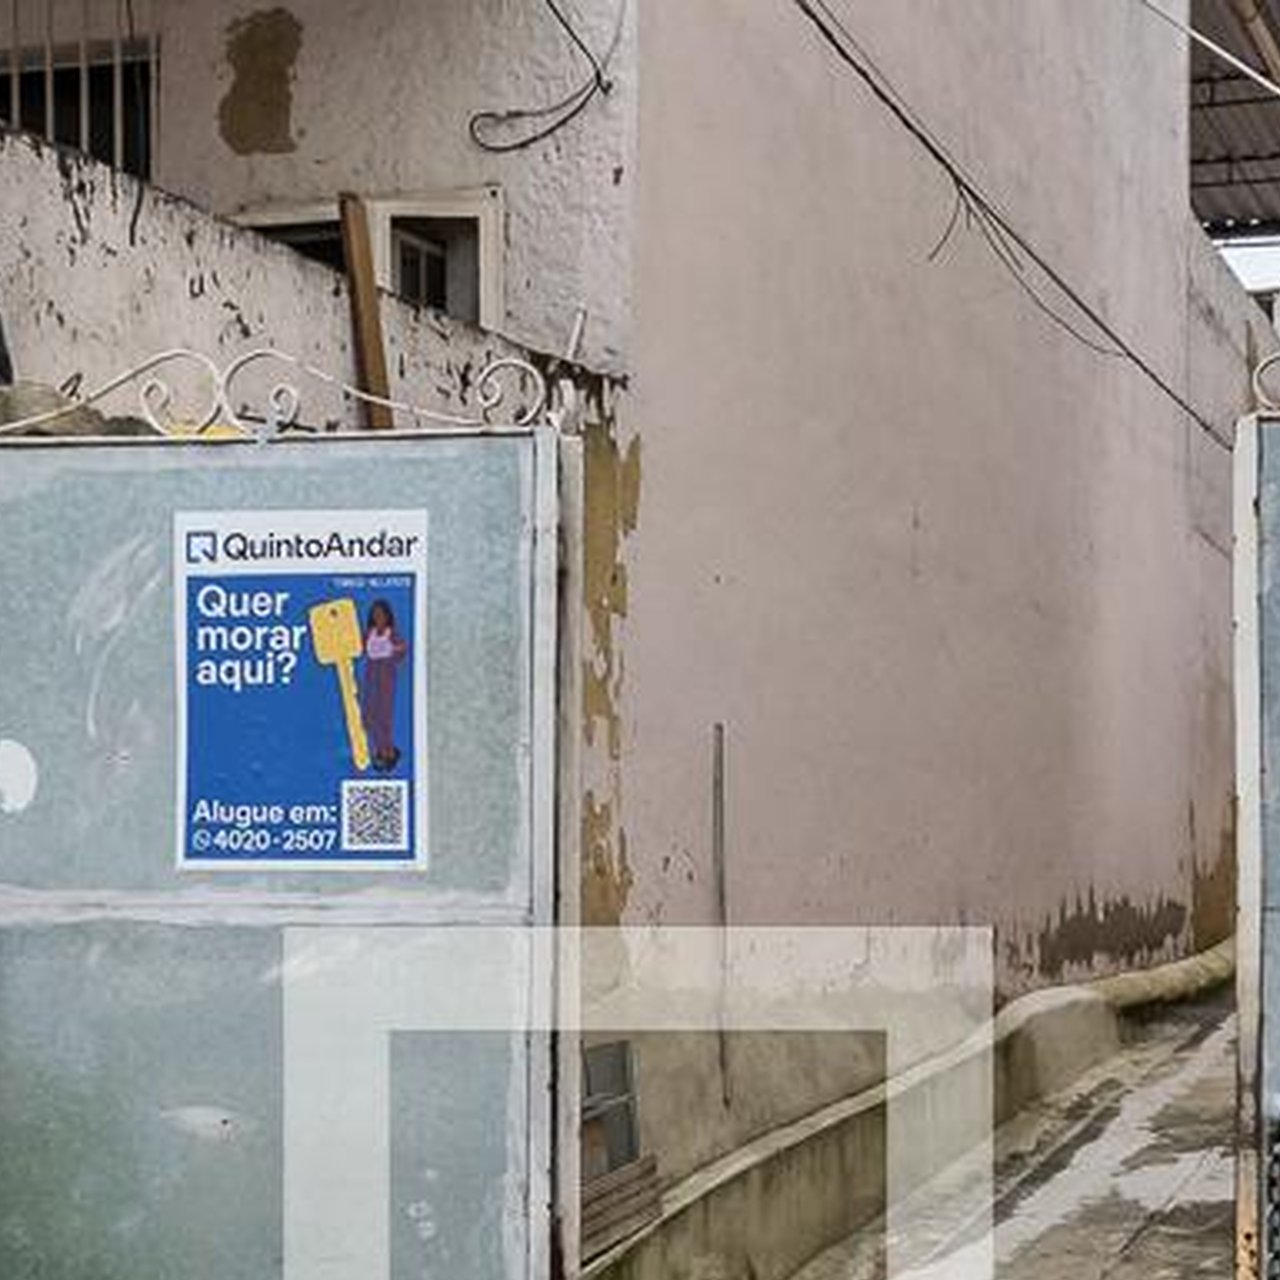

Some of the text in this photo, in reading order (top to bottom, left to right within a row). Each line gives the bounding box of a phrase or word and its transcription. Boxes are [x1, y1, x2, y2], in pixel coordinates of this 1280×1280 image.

[223, 530, 418, 561] QuintoAndar
[197, 585, 290, 618] Quer
[197, 625, 307, 651] morar
[196, 651, 297, 692] aqui?
[192, 799, 337, 828] Alugue em:
